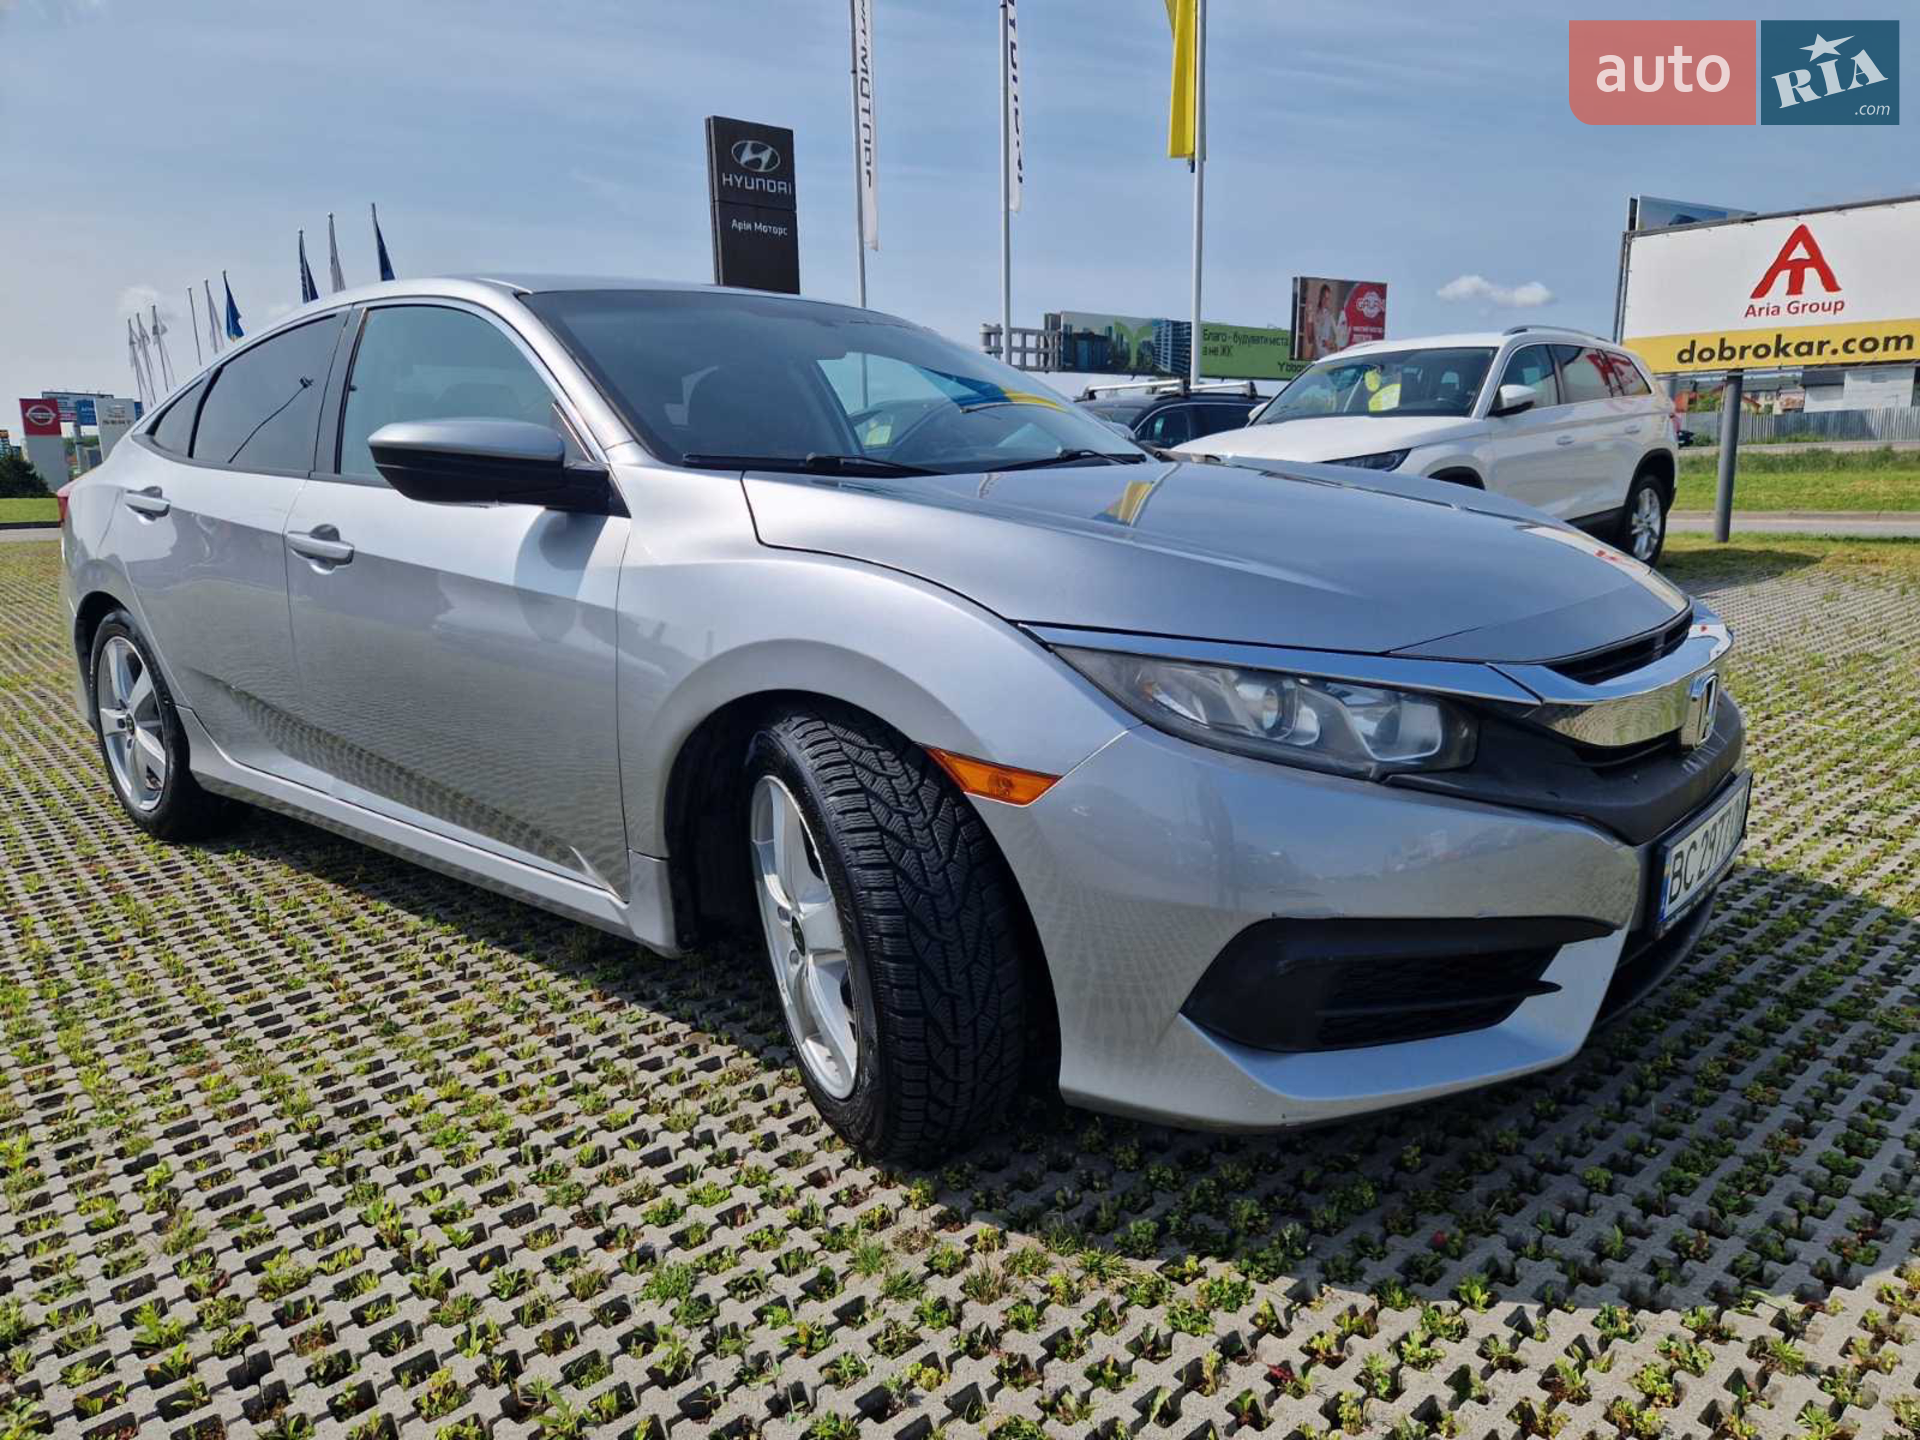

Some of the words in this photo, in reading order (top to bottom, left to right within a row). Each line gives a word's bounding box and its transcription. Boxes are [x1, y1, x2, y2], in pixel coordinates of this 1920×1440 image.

[721, 173, 792, 195] HYUNDAI
[1744, 303, 1780, 318] Aria
[1787, 299, 1845, 315] Group
[1676, 333, 1914, 364] dobrokar.com
